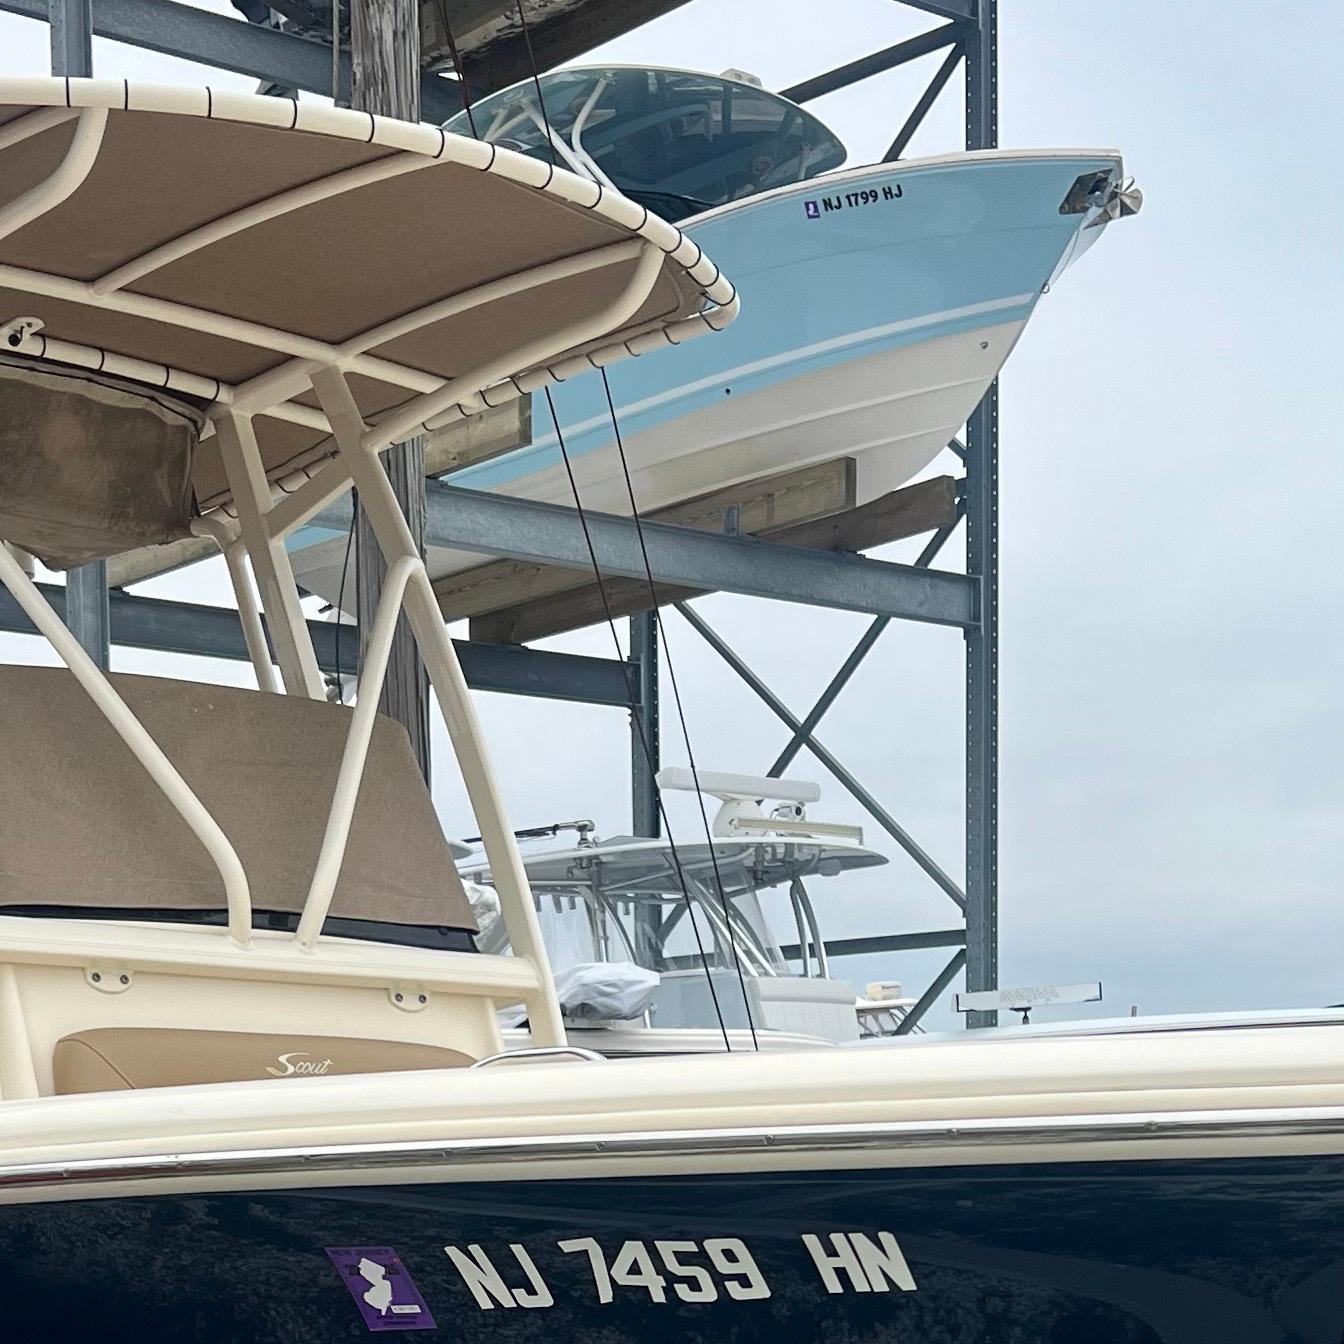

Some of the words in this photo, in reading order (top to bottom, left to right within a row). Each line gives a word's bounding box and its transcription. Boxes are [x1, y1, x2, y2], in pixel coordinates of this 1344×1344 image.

[822, 197, 842, 212] NJ
[845, 190, 878, 207] 1799
[882, 184, 903, 201] HJ
[265, 1052, 333, 1077] Scout
[444, 1244, 554, 1309] NJ
[558, 1238, 772, 1303] 7459
[802, 1231, 918, 1294] HN
